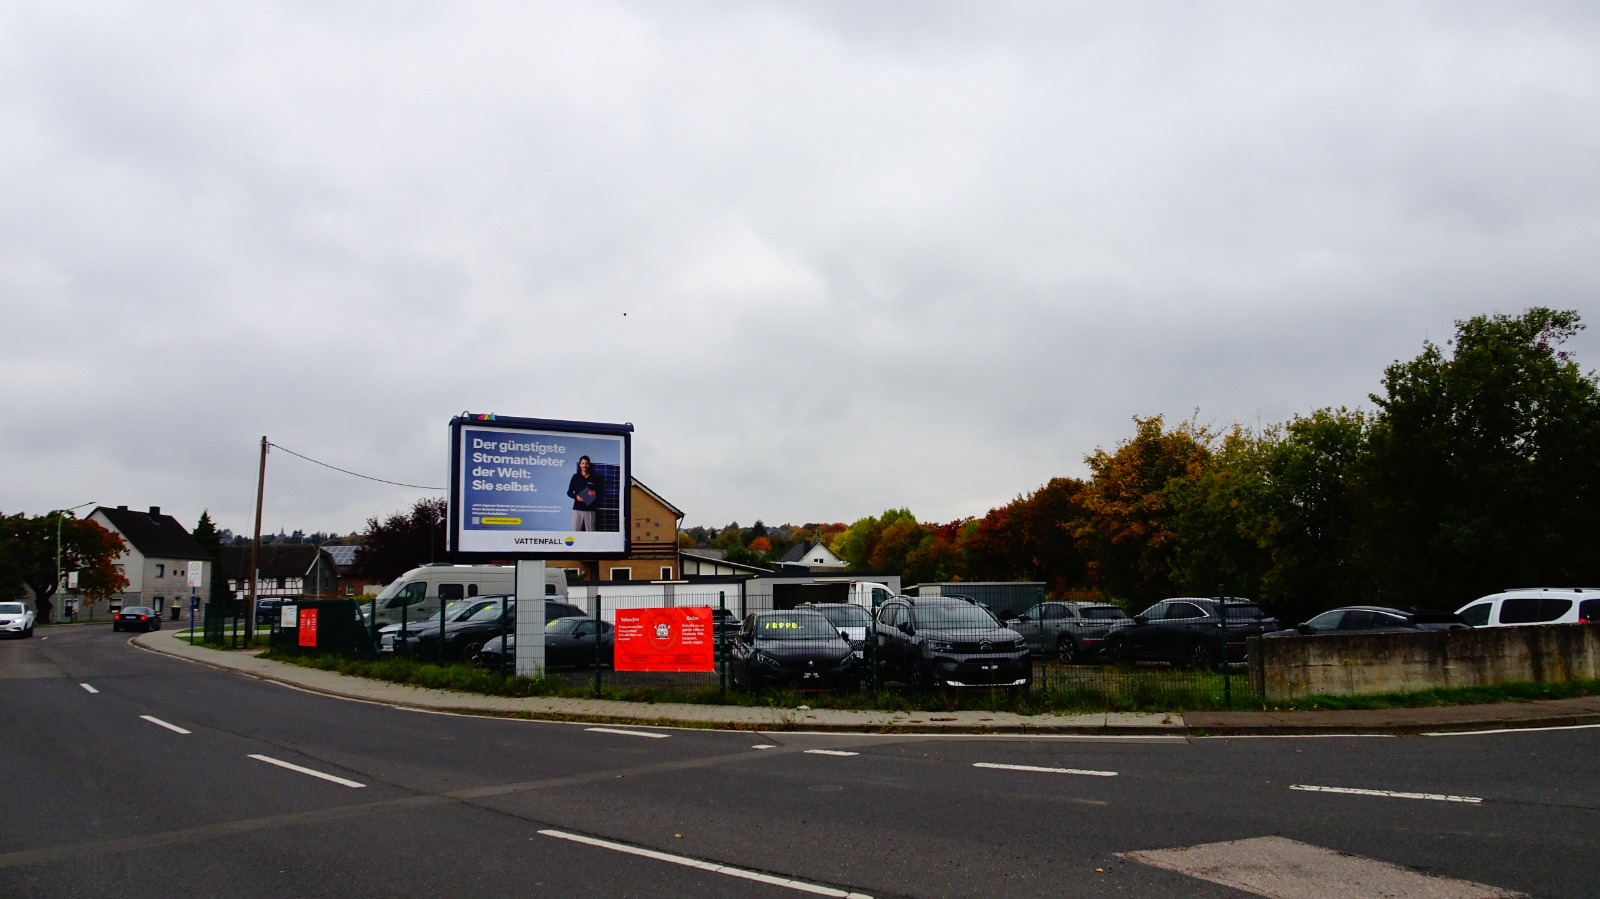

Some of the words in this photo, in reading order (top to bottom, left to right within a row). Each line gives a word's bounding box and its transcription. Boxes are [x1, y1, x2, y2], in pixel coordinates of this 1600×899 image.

[473, 438, 497, 450] Der
[499, 440, 566, 455] günstigste
[472, 452, 565, 467] Stromanbieter
[472, 466, 495, 478] der
[497, 467, 531, 479] Welt:
[472, 480, 493, 491] Sie
[495, 480, 538, 492] selbst.
[514, 537, 563, 545] VATTENFALL
